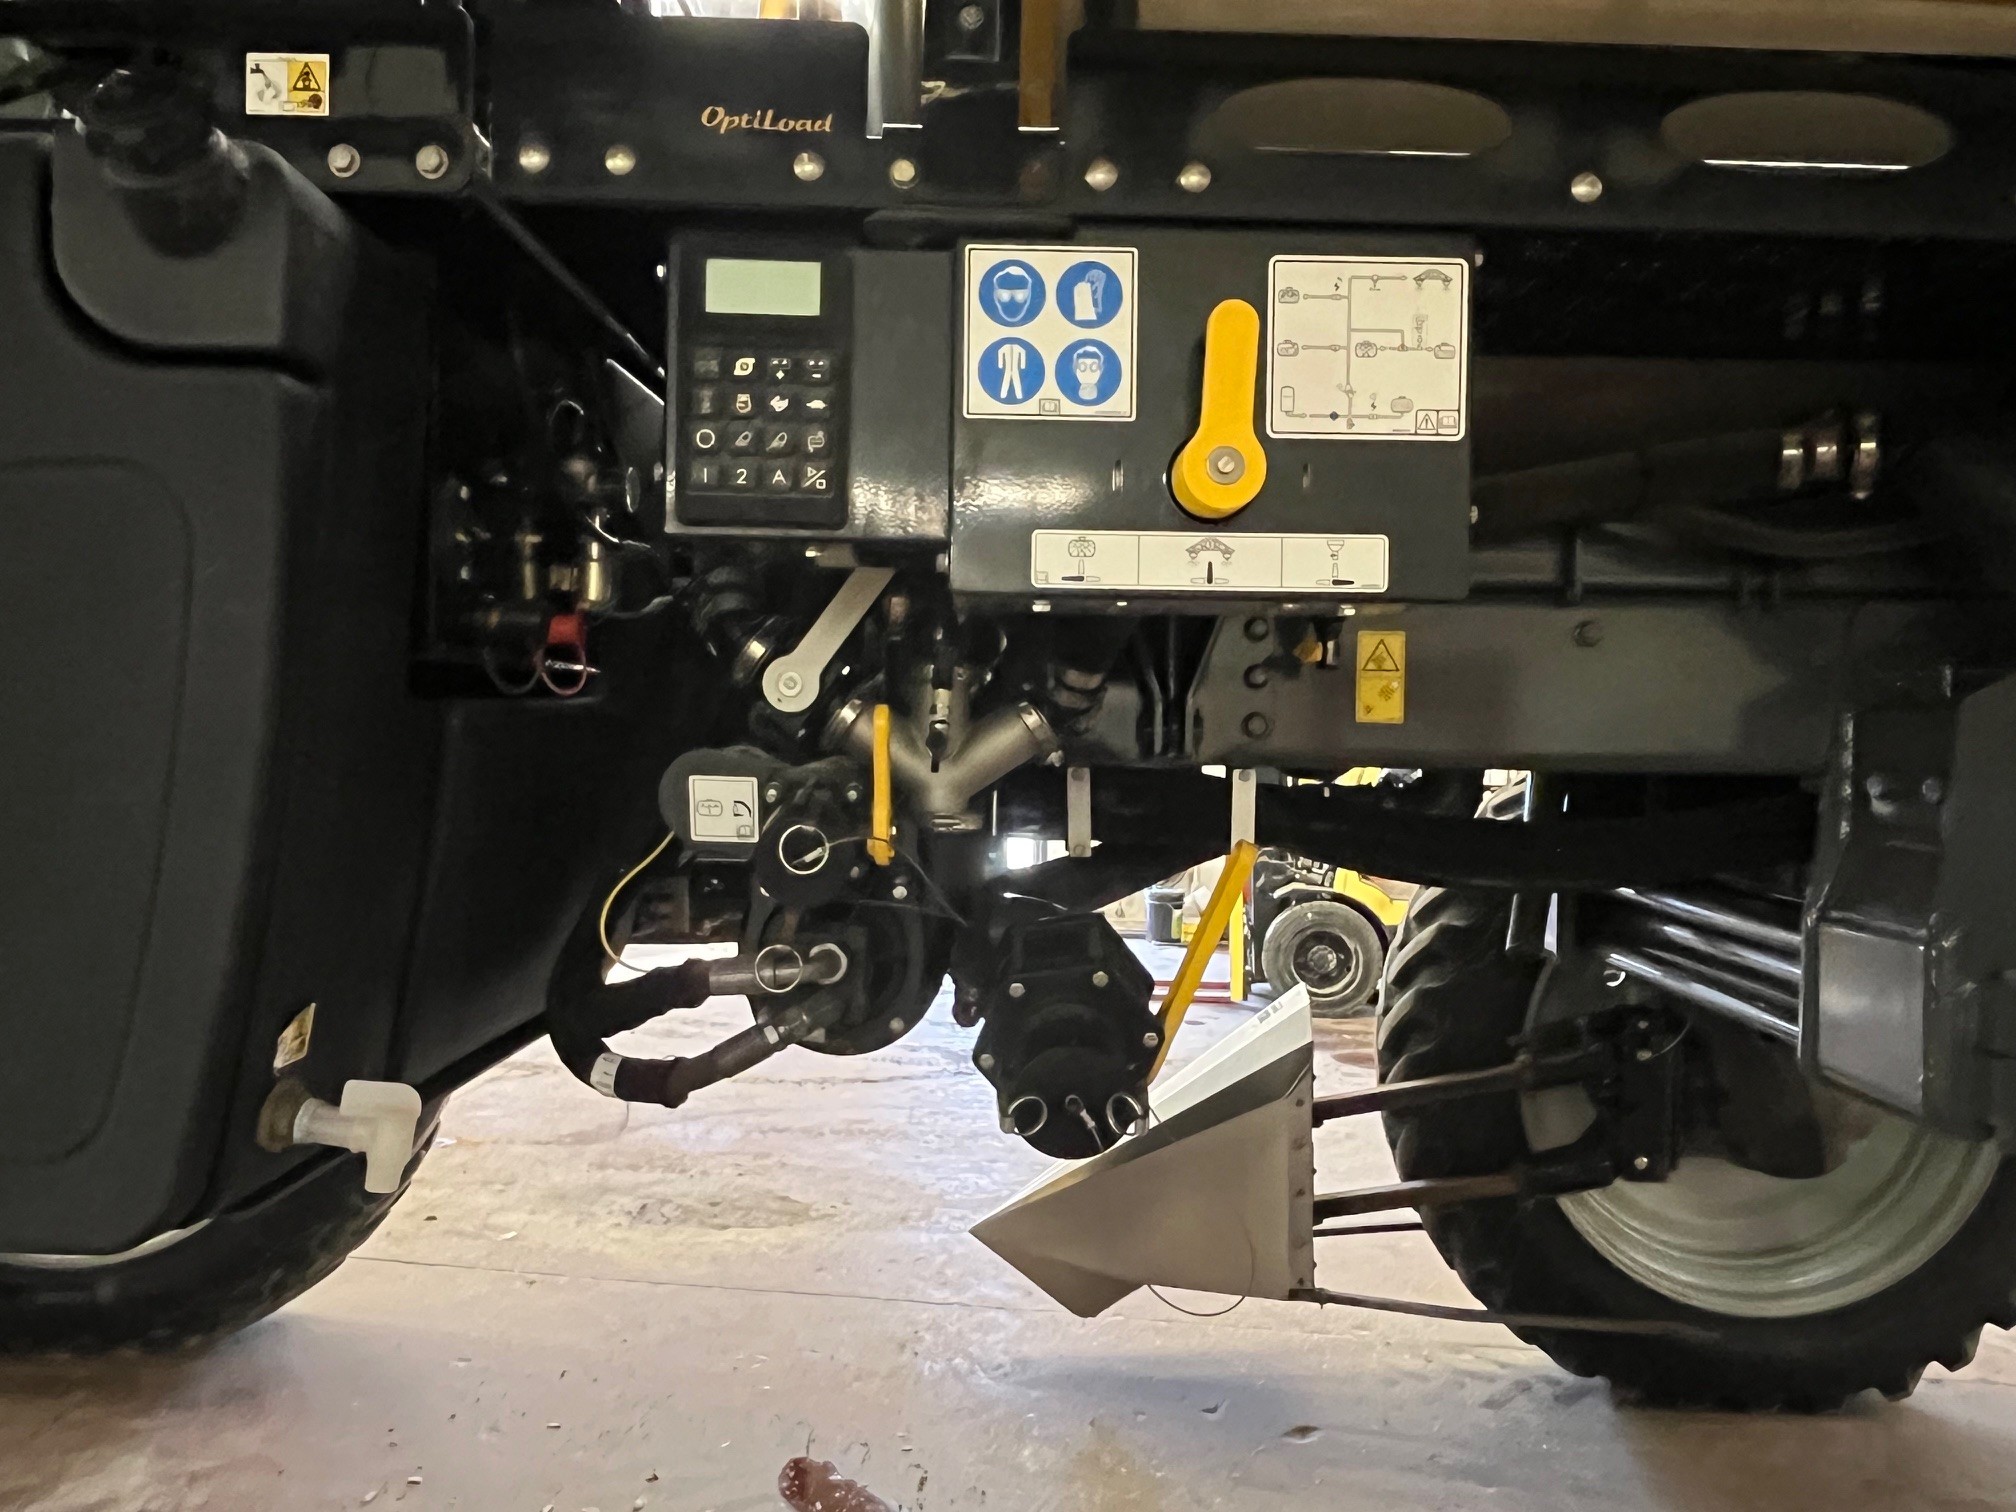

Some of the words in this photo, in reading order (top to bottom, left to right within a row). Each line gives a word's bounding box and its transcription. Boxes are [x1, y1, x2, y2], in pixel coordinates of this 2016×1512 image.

[701, 106, 833, 134] OptiLoad
[736, 468, 747, 484] 2
[772, 469, 787, 485] A
